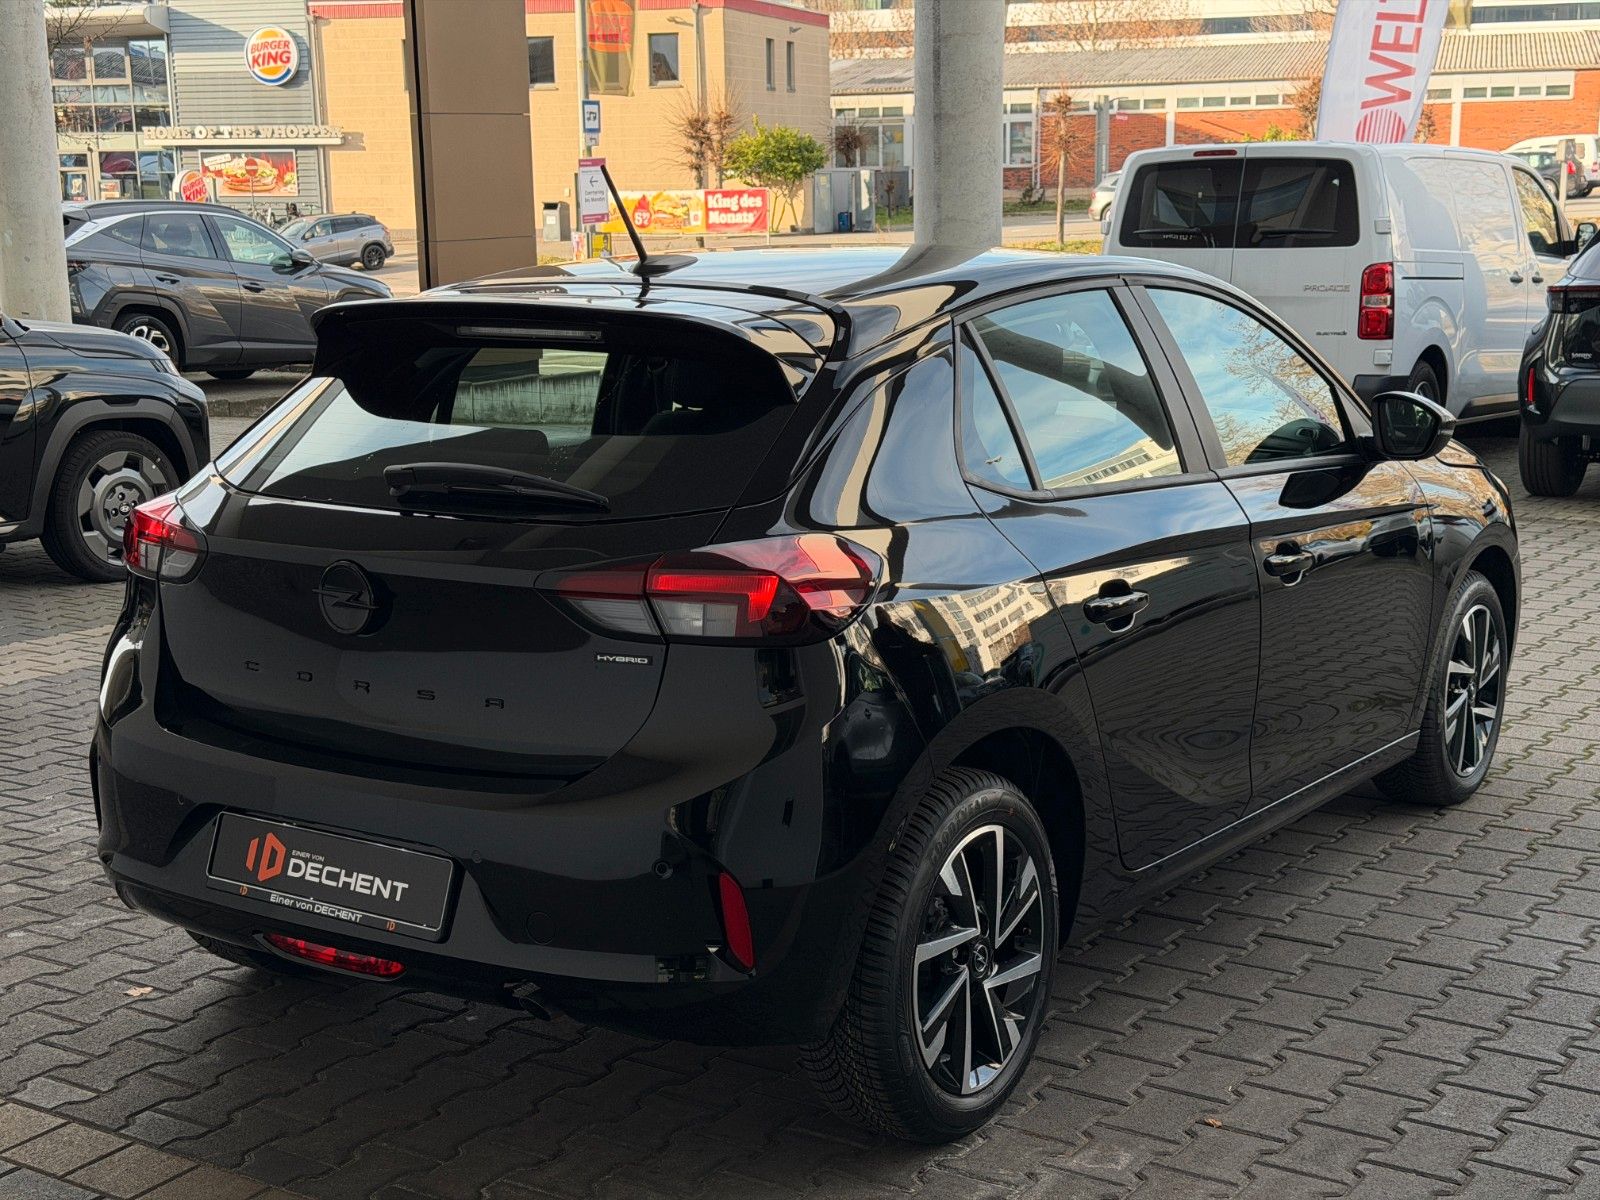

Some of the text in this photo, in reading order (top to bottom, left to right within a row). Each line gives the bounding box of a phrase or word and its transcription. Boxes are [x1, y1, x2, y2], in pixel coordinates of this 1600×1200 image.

[250, 40, 291, 54] BURGER
[1360, 0, 1428, 110] WEL
[251, 51, 292, 70] KING
[142, 124, 344, 139] HOME OF THE WHOPPER
[185, 183, 207, 202] KING
[707, 193, 739, 211] King
[740, 193, 762, 208] des
[709, 211, 755, 225] Monats
[1304, 284, 1351, 293] PROACE
[597, 655, 648, 664] HYBRID
[244, 660, 505, 709] CORSA
[291, 849, 325, 862] EINER VON
[286, 858, 409, 902] DECHENT
[269, 893, 363, 923] Einer von DECHENT
